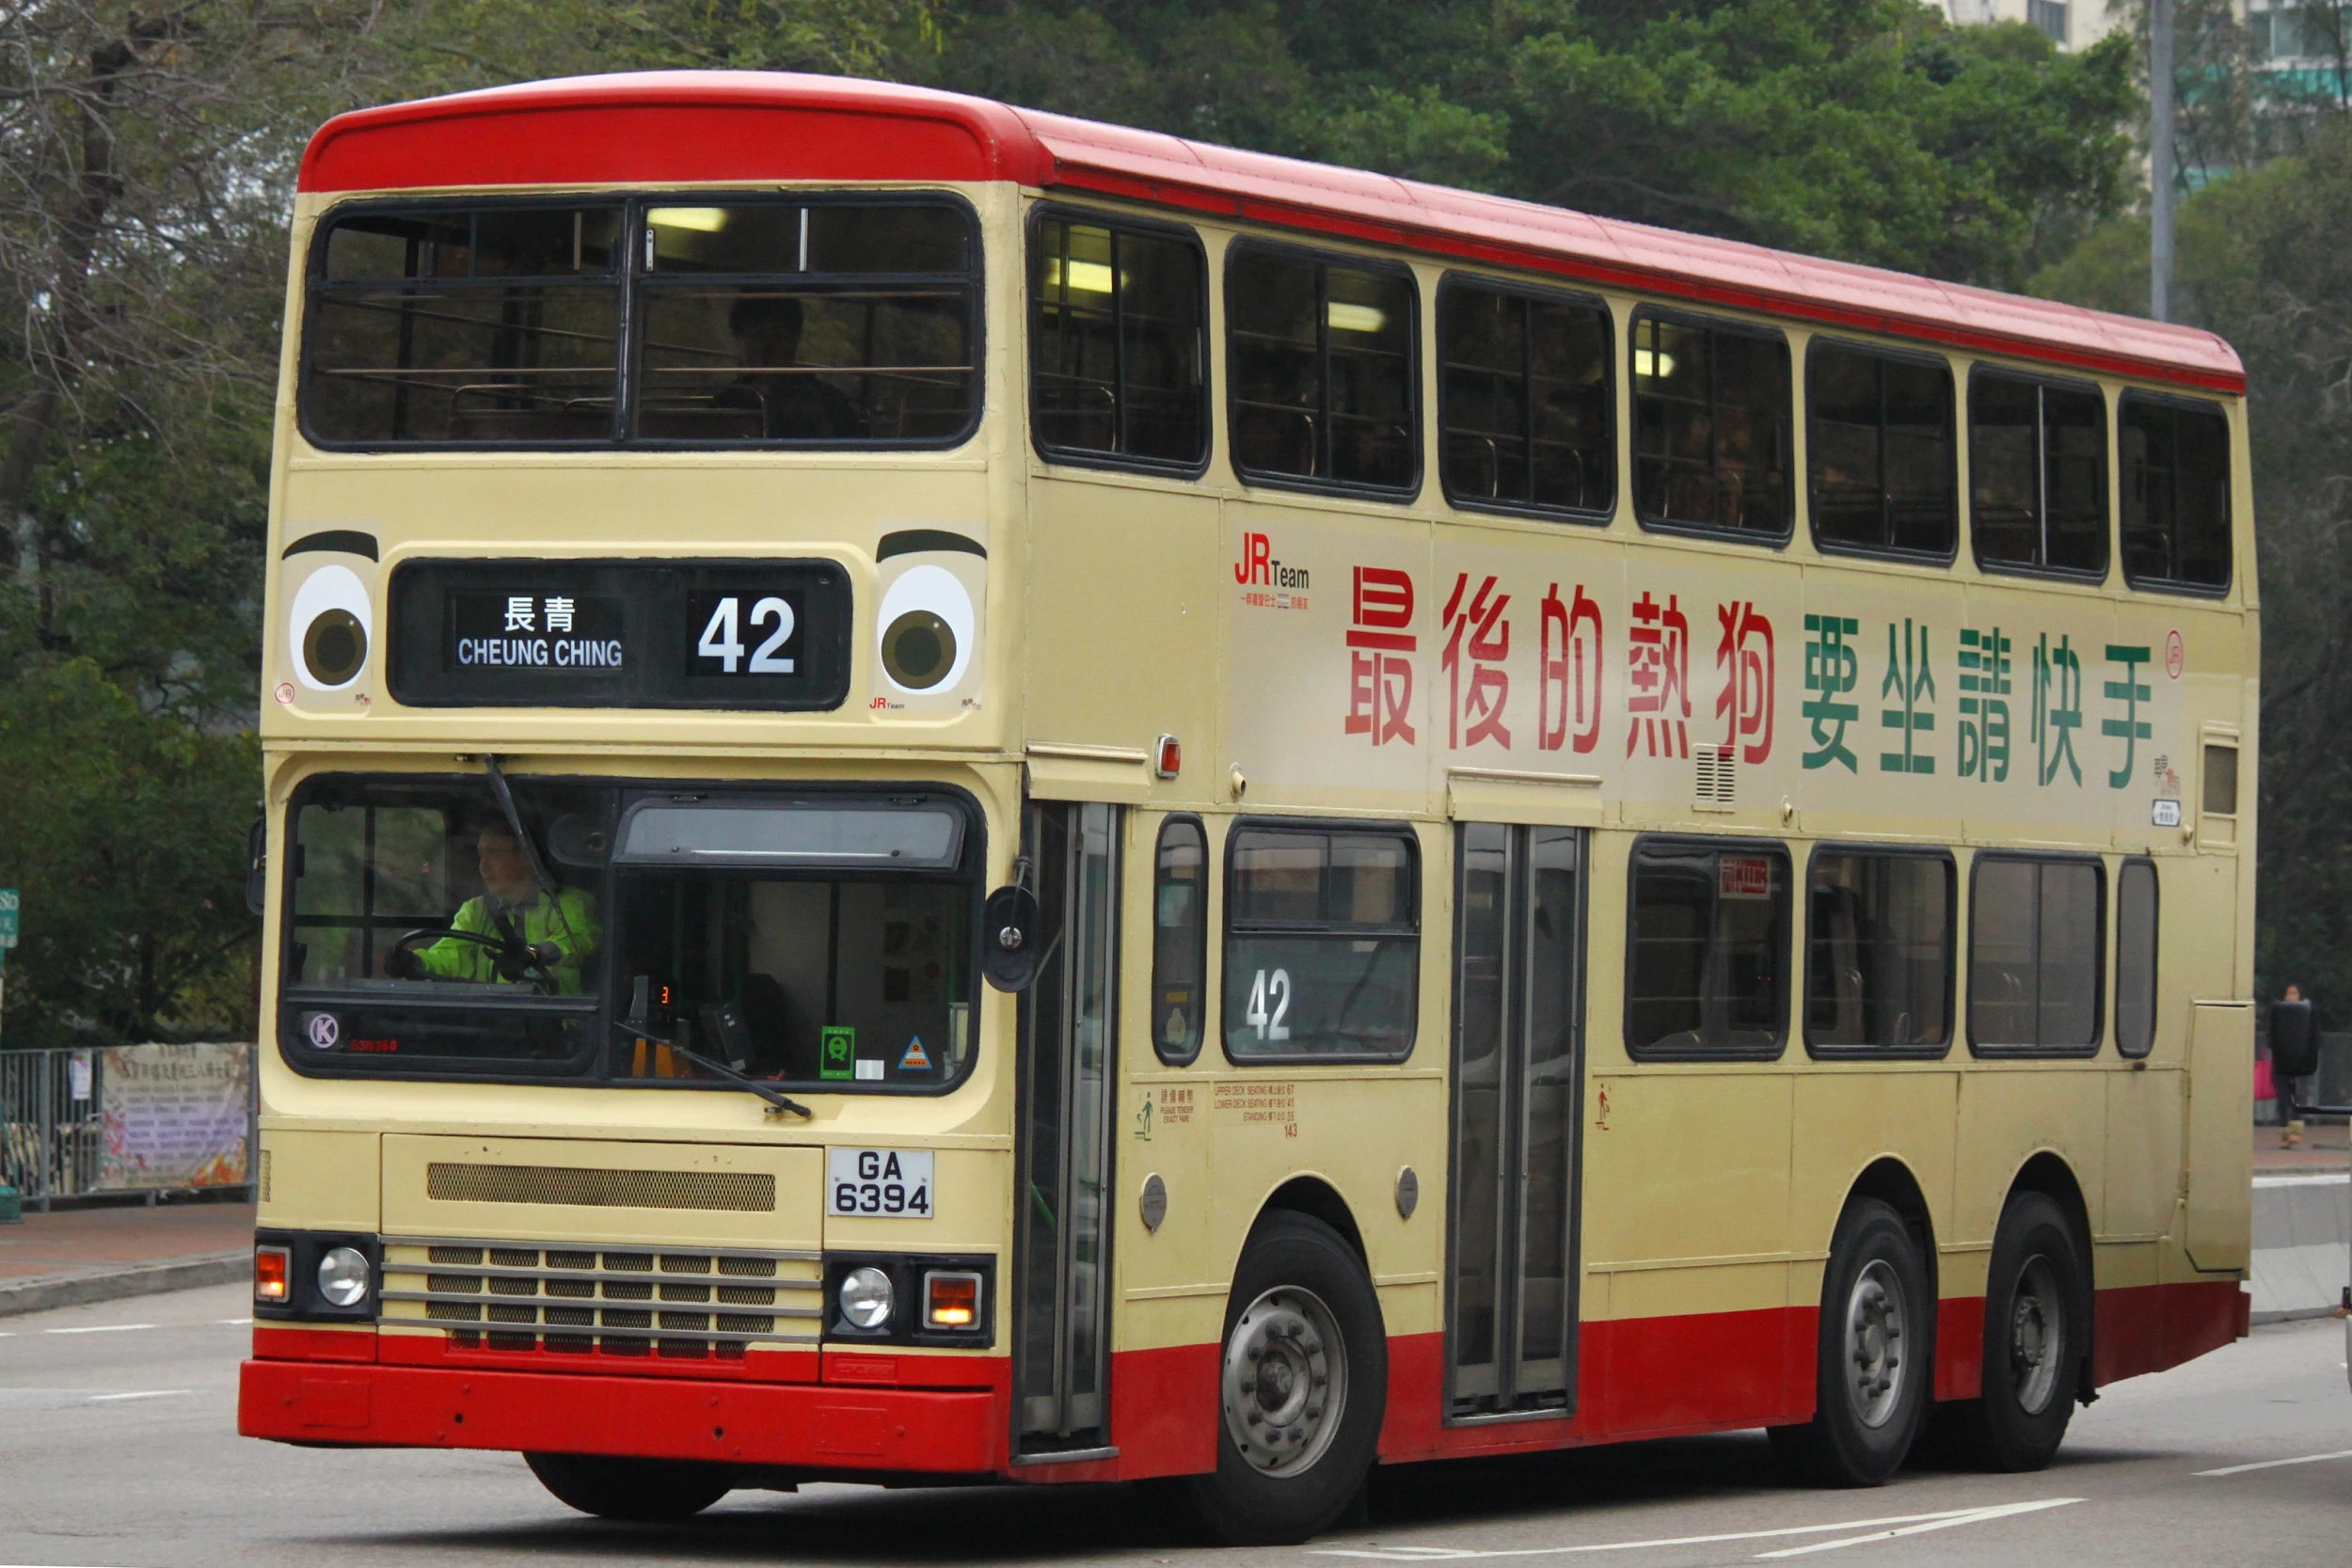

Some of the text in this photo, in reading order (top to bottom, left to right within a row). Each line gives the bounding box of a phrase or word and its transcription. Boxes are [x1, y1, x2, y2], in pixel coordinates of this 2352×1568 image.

[1234, 531, 1310, 589] JR Team
[503, 596, 577, 632] 長青
[696, 596, 796, 674] 42
[457, 639, 624, 668] CHEUNG CHING
[869, 697, 886, 709] JR
[1246, 968, 1292, 1040] 42
[1215, 1086, 1232, 1096] UPPER
[1232, 1085, 1246, 1095] DECK
[1248, 1085, 1267, 1095] SEATING
[1287, 1084, 1295, 1095] 67
[1215, 1100, 1232, 1110] LOWER
[1233, 1099, 1246, 1109] DECK
[1248, 1099, 1267, 1108] SEATING
[1287, 1098, 1295, 1108] 41
[1177, 1105, 1193, 1114] TENDER
[1244, 1112, 1267, 1121] STANDING
[1287, 1111, 1295, 1121] 35
[1285, 1123, 1297, 1138] 143
[858, 1151, 902, 1180] GA
[835, 1182, 930, 1214] 6394
